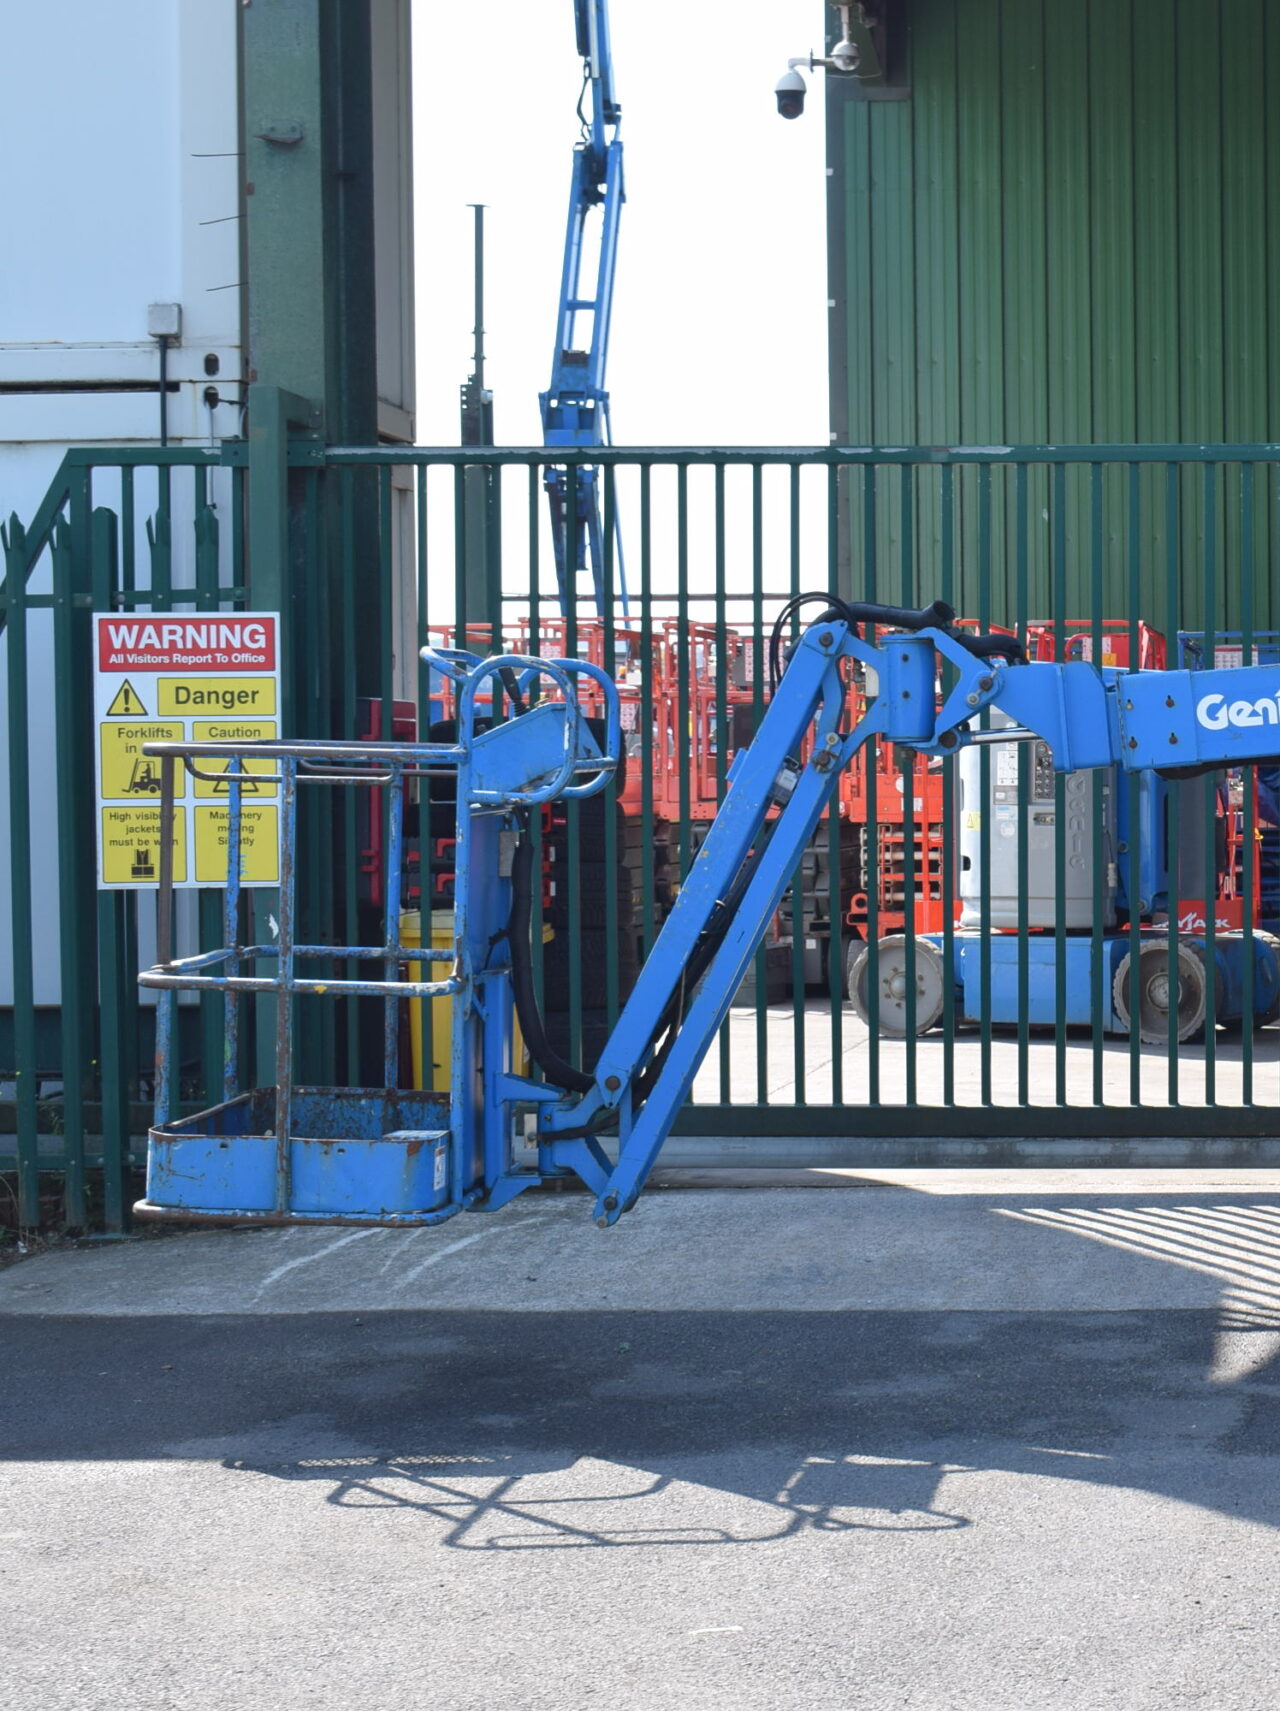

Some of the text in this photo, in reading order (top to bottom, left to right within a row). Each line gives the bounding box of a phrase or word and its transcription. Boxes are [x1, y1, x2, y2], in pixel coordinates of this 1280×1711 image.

[108, 624, 266, 649] WARNING
[109, 653, 266, 665] All Visitors Report To Office
[175, 686, 259, 709] Danger
[117, 727, 173, 739] Forklifts
[208, 727, 261, 738] Caution
[125, 744, 137, 753] in
[109, 812, 131, 822] High
[109, 838, 179, 846] must be wn
